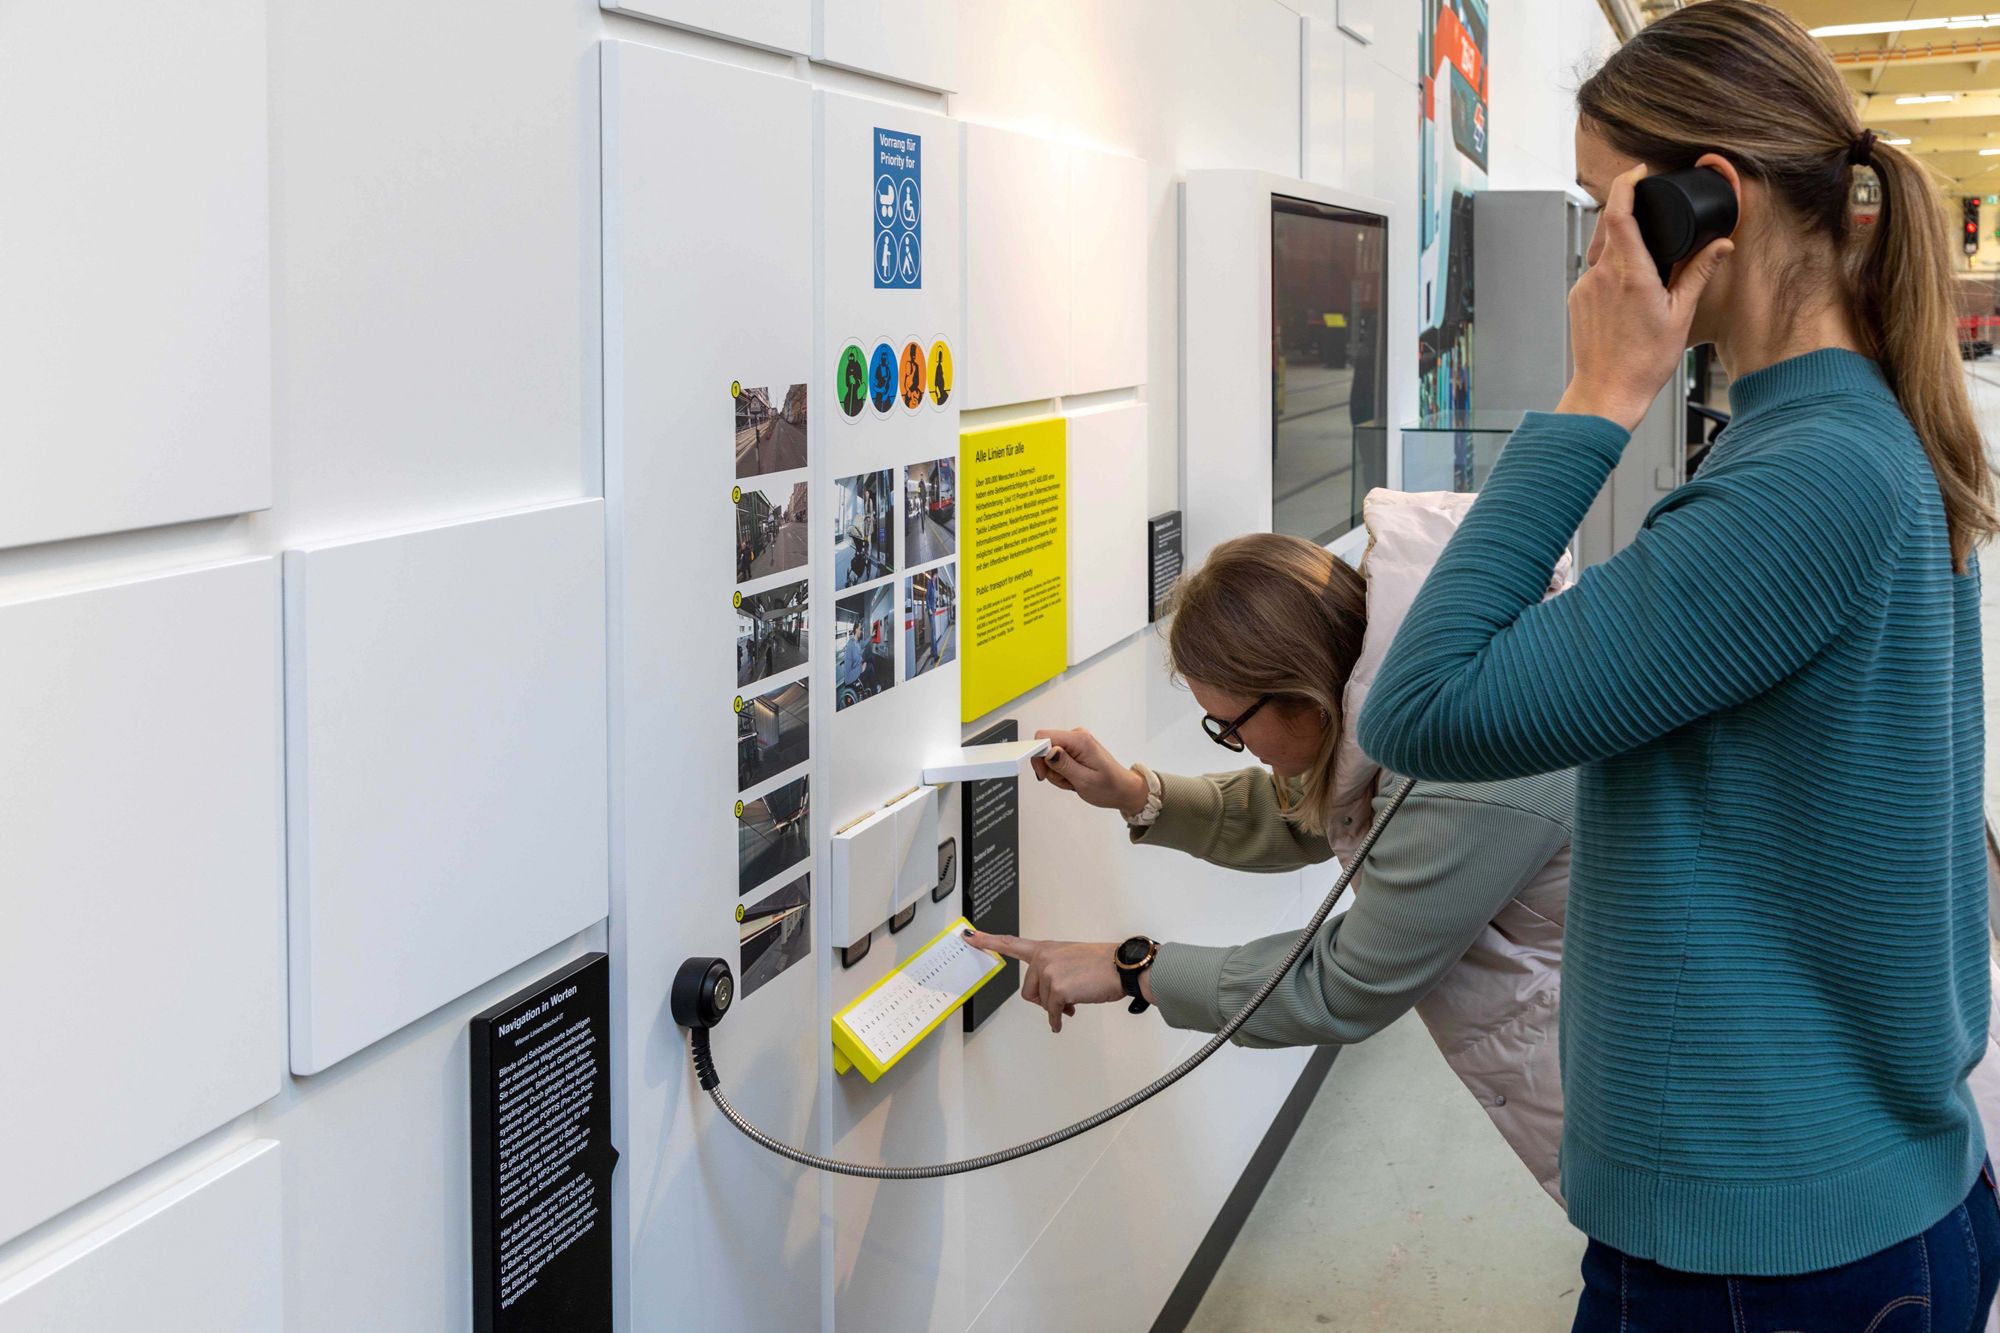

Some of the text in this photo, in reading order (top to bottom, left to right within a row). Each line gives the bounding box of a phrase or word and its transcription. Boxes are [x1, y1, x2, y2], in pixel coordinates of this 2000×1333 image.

[880, 133, 916, 153] Vorrang für
[880, 151, 916, 170] Priority for
[976, 443, 1024, 462] Alle Linien für alle
[976, 585, 989, 596] Public
[990, 578, 1007, 591] transport
[1015, 569, 1033, 581] everybody
[499, 986, 577, 1037] Navigation in Worten
[499, 1063, 516, 1077] Blinde
[517, 1054, 528, 1066] und
[565, 1059, 576, 1071] oder
[499, 1077, 511, 1089] sehr
[499, 1091, 508, 1101] Sie
[538, 1065, 549, 1076] sich
[530, 1091, 544, 1105] Doch
[500, 1129, 522, 1148] Deshalb
[523, 1118, 539, 1132] wurde
[508, 1153, 519, 1168] gibt
[582, 1106, 590, 1115] die
[522, 1167, 532, 1180] und
[533, 1161, 543, 1172] das
[566, 1134, 581, 1149] Hause
[530, 1152, 540, 1163] des
[540, 1138, 558, 1155] Wiener
[501, 1226, 512, 1239] Hier
[521, 1214, 529, 1224] die
[576, 1172, 585, 1183] von
